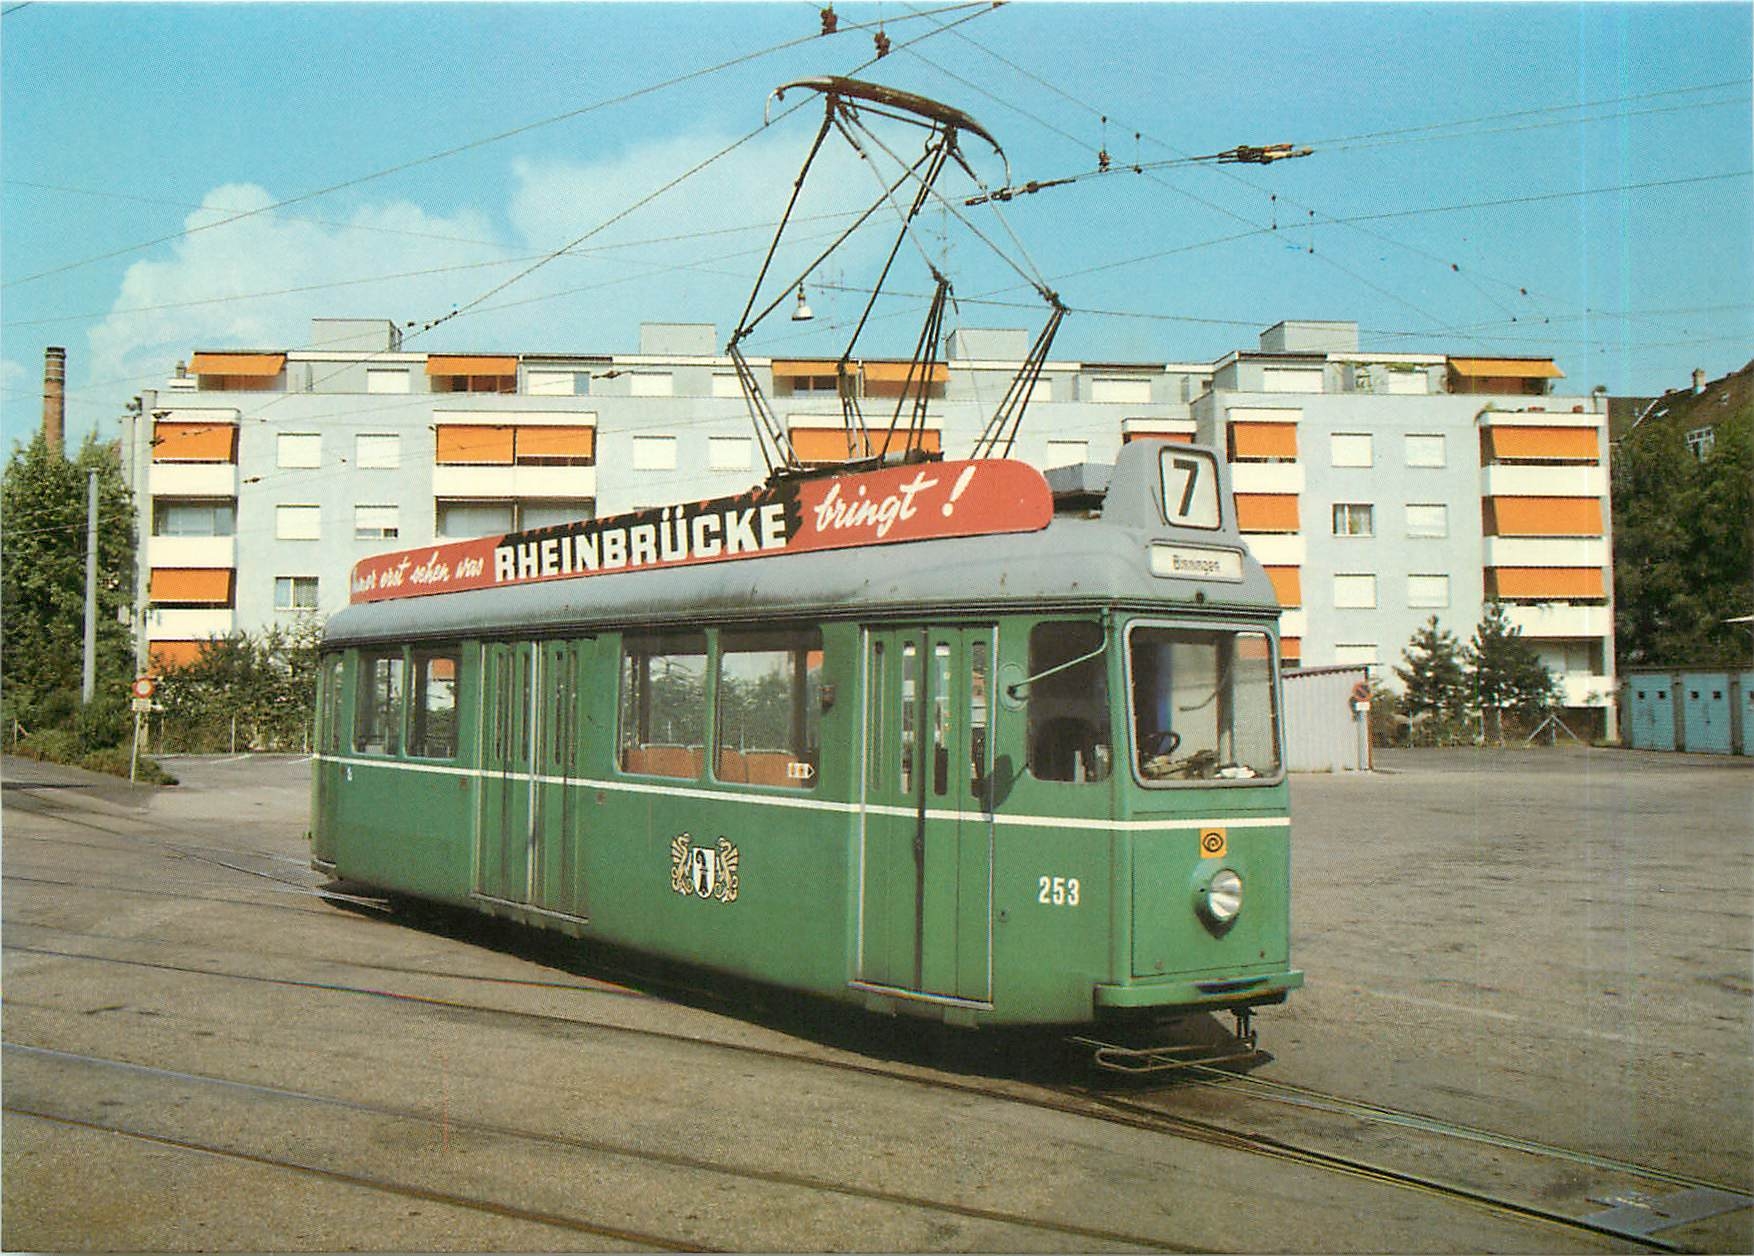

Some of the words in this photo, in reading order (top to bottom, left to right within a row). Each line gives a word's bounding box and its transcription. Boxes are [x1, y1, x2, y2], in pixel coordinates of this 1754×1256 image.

[1173, 458, 1199, 516] 7
[494, 503, 787, 583] RHEINBRÜCKE
[813, 471, 939, 538] bringt
[1038, 875, 1081, 906] 253
